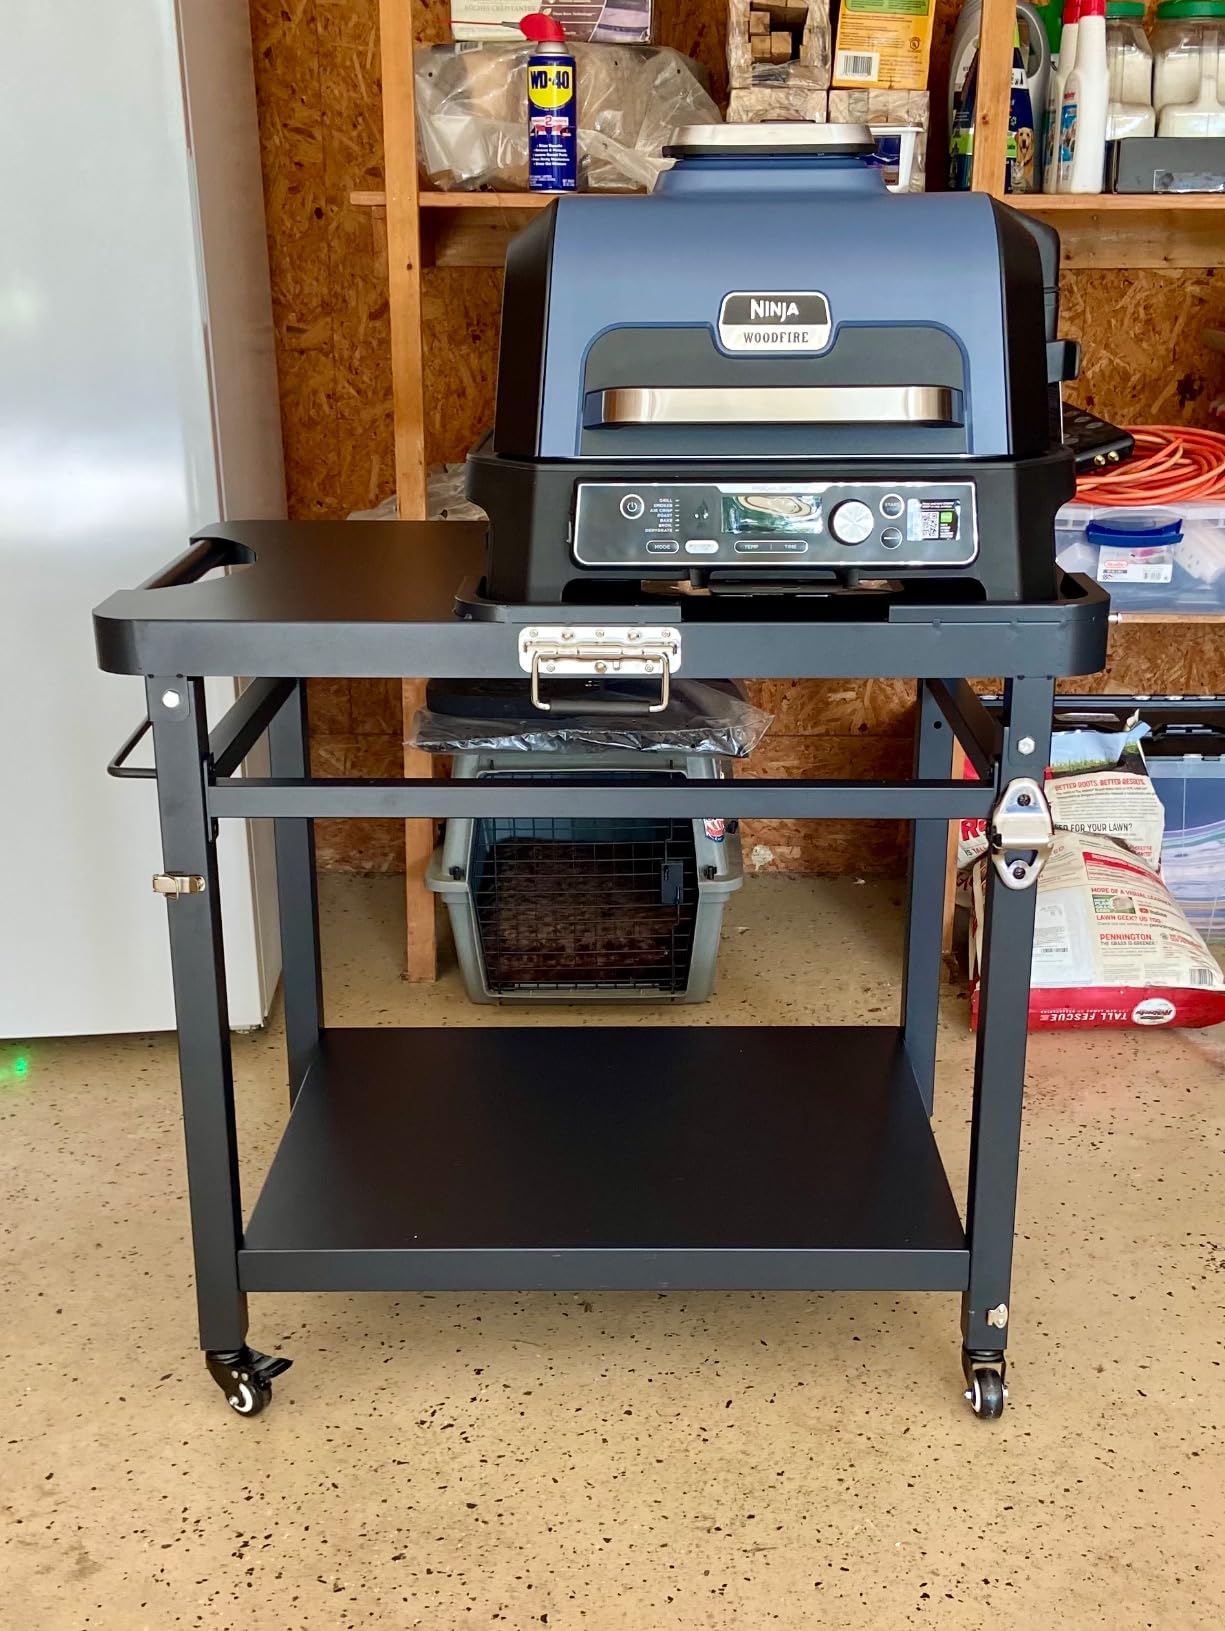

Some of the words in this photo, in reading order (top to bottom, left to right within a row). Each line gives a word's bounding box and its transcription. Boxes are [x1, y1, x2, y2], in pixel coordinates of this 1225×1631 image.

[531, 71, 569, 89] WD-40
[743, 331, 809, 343] WOODFIRE
[1055, 783, 1077, 791] BETTER
[1100, 778, 1121, 786] BETTER
[1070, 824, 1086, 832] FOR
[1087, 823, 1107, 832] YOUR
[1108, 822, 1133, 832] LAWN?
[1099, 933, 1152, 941] PENNINGTON
[1050, 1012, 1096, 1022] FESCUE
[1100, 1011, 1128, 1021] TALL
